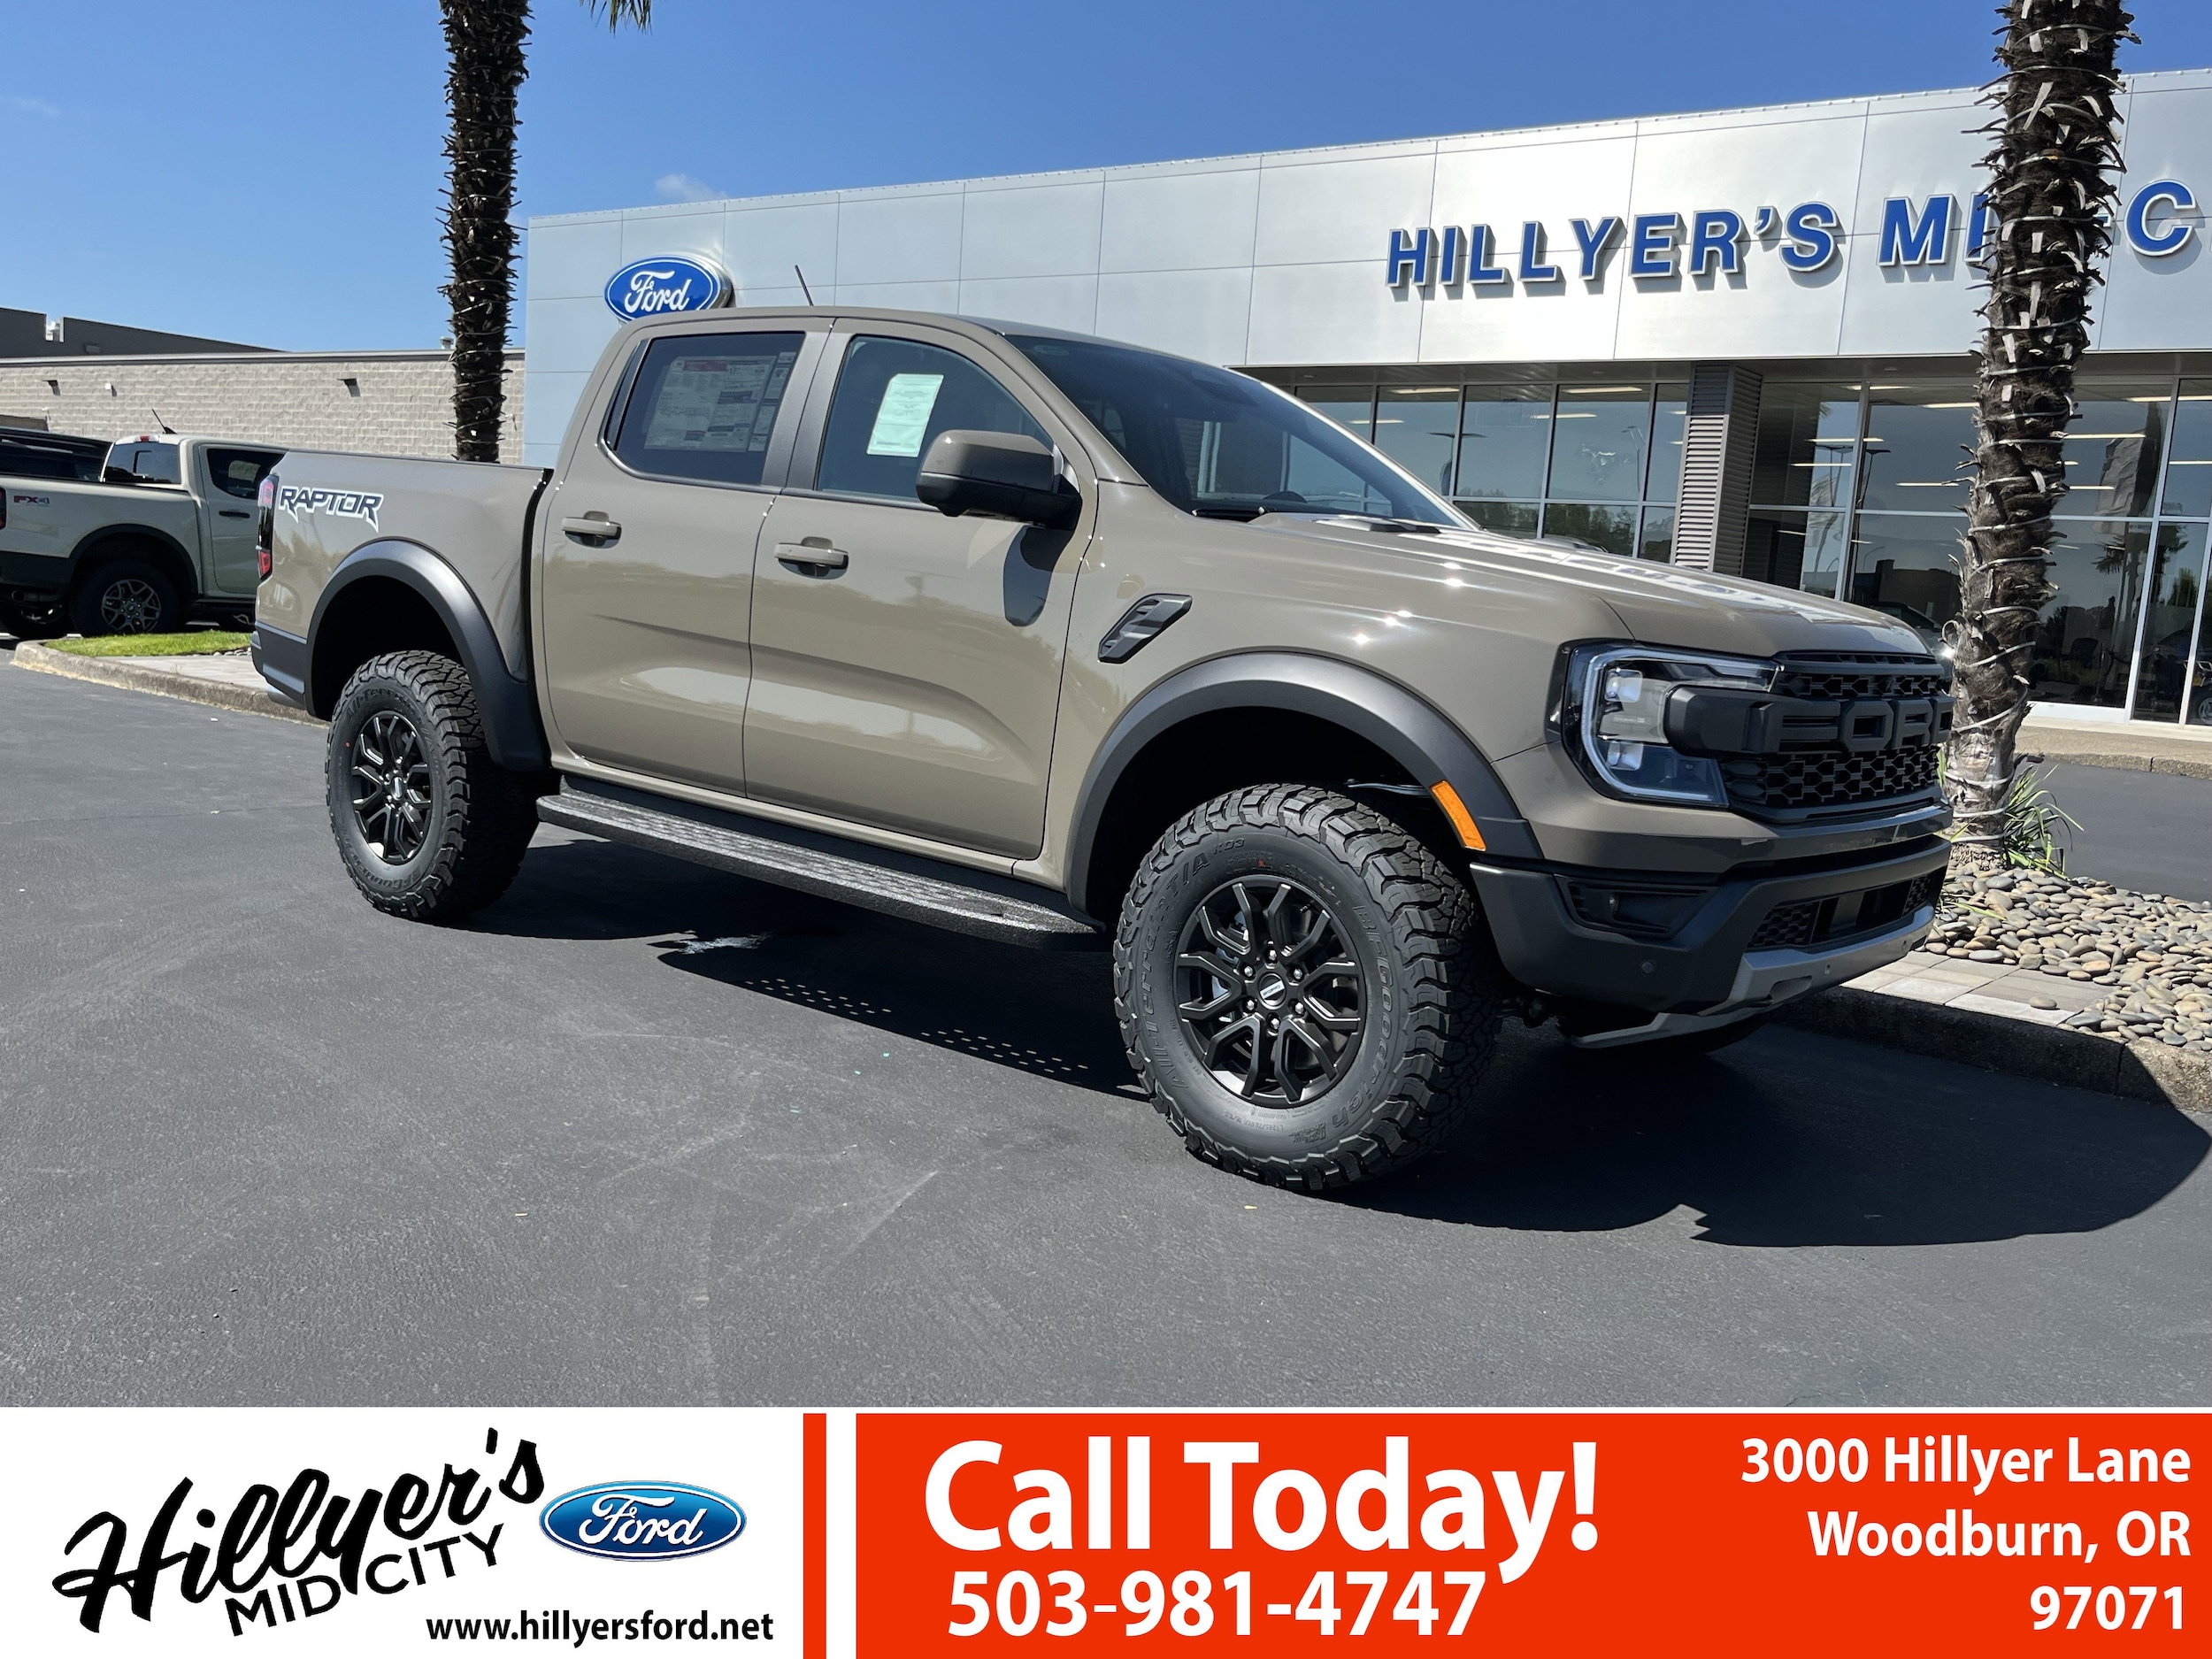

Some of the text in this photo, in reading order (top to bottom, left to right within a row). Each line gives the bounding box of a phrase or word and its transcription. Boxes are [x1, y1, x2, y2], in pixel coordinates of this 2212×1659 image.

[1386, 179, 2197, 288] HILLYER'S MIC
[624, 270, 693, 313] Ford
[278, 485, 384, 534] RAPTOR
[1331, 903, 1394, 1129] BFGoodrich
